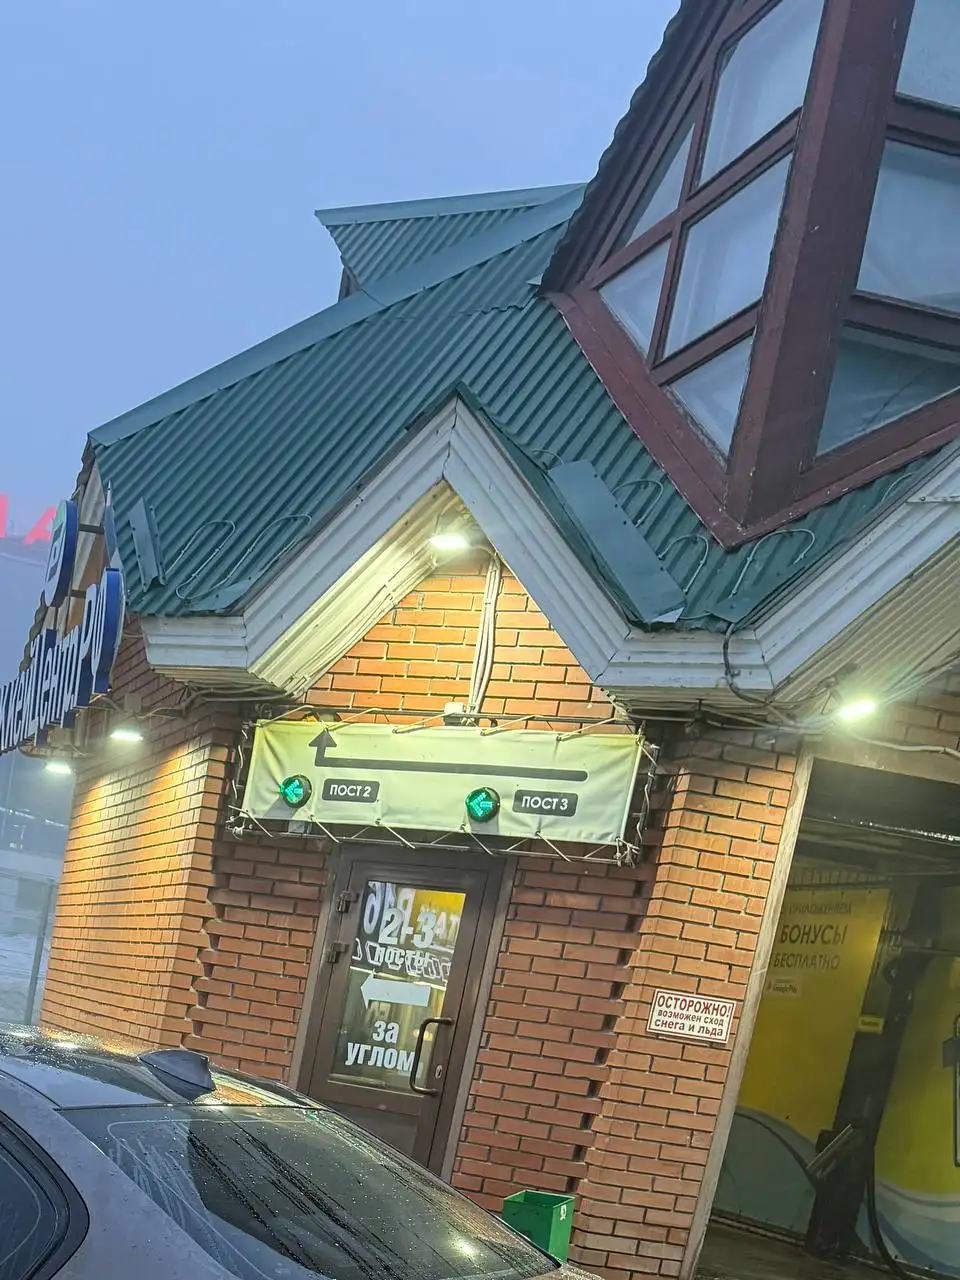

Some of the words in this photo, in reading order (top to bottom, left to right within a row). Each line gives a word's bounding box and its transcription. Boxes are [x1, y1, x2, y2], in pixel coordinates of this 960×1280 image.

[328, 784, 362, 798] ПОСТ
[362, 786, 372, 798] 2
[521, 795, 558, 810] ПОСТ
[558, 798, 569, 811] 3
[378, 907, 436, 948] 2-3
[780, 924, 848, 945] БОНУСЫ
[773, 952, 840, 970] БЕСПЛАТНО
[657, 995, 731, 1018] ОСТОРОЖНО!
[658, 1009, 701, 1023] возможен
[704, 1016, 724, 1027] сход
[372, 1021, 400, 1043] за
[654, 1019, 685, 1031] снега
[688, 1024, 695, 1032] и
[698, 1026, 723, 1037] льда
[345, 1042, 415, 1071] углом
